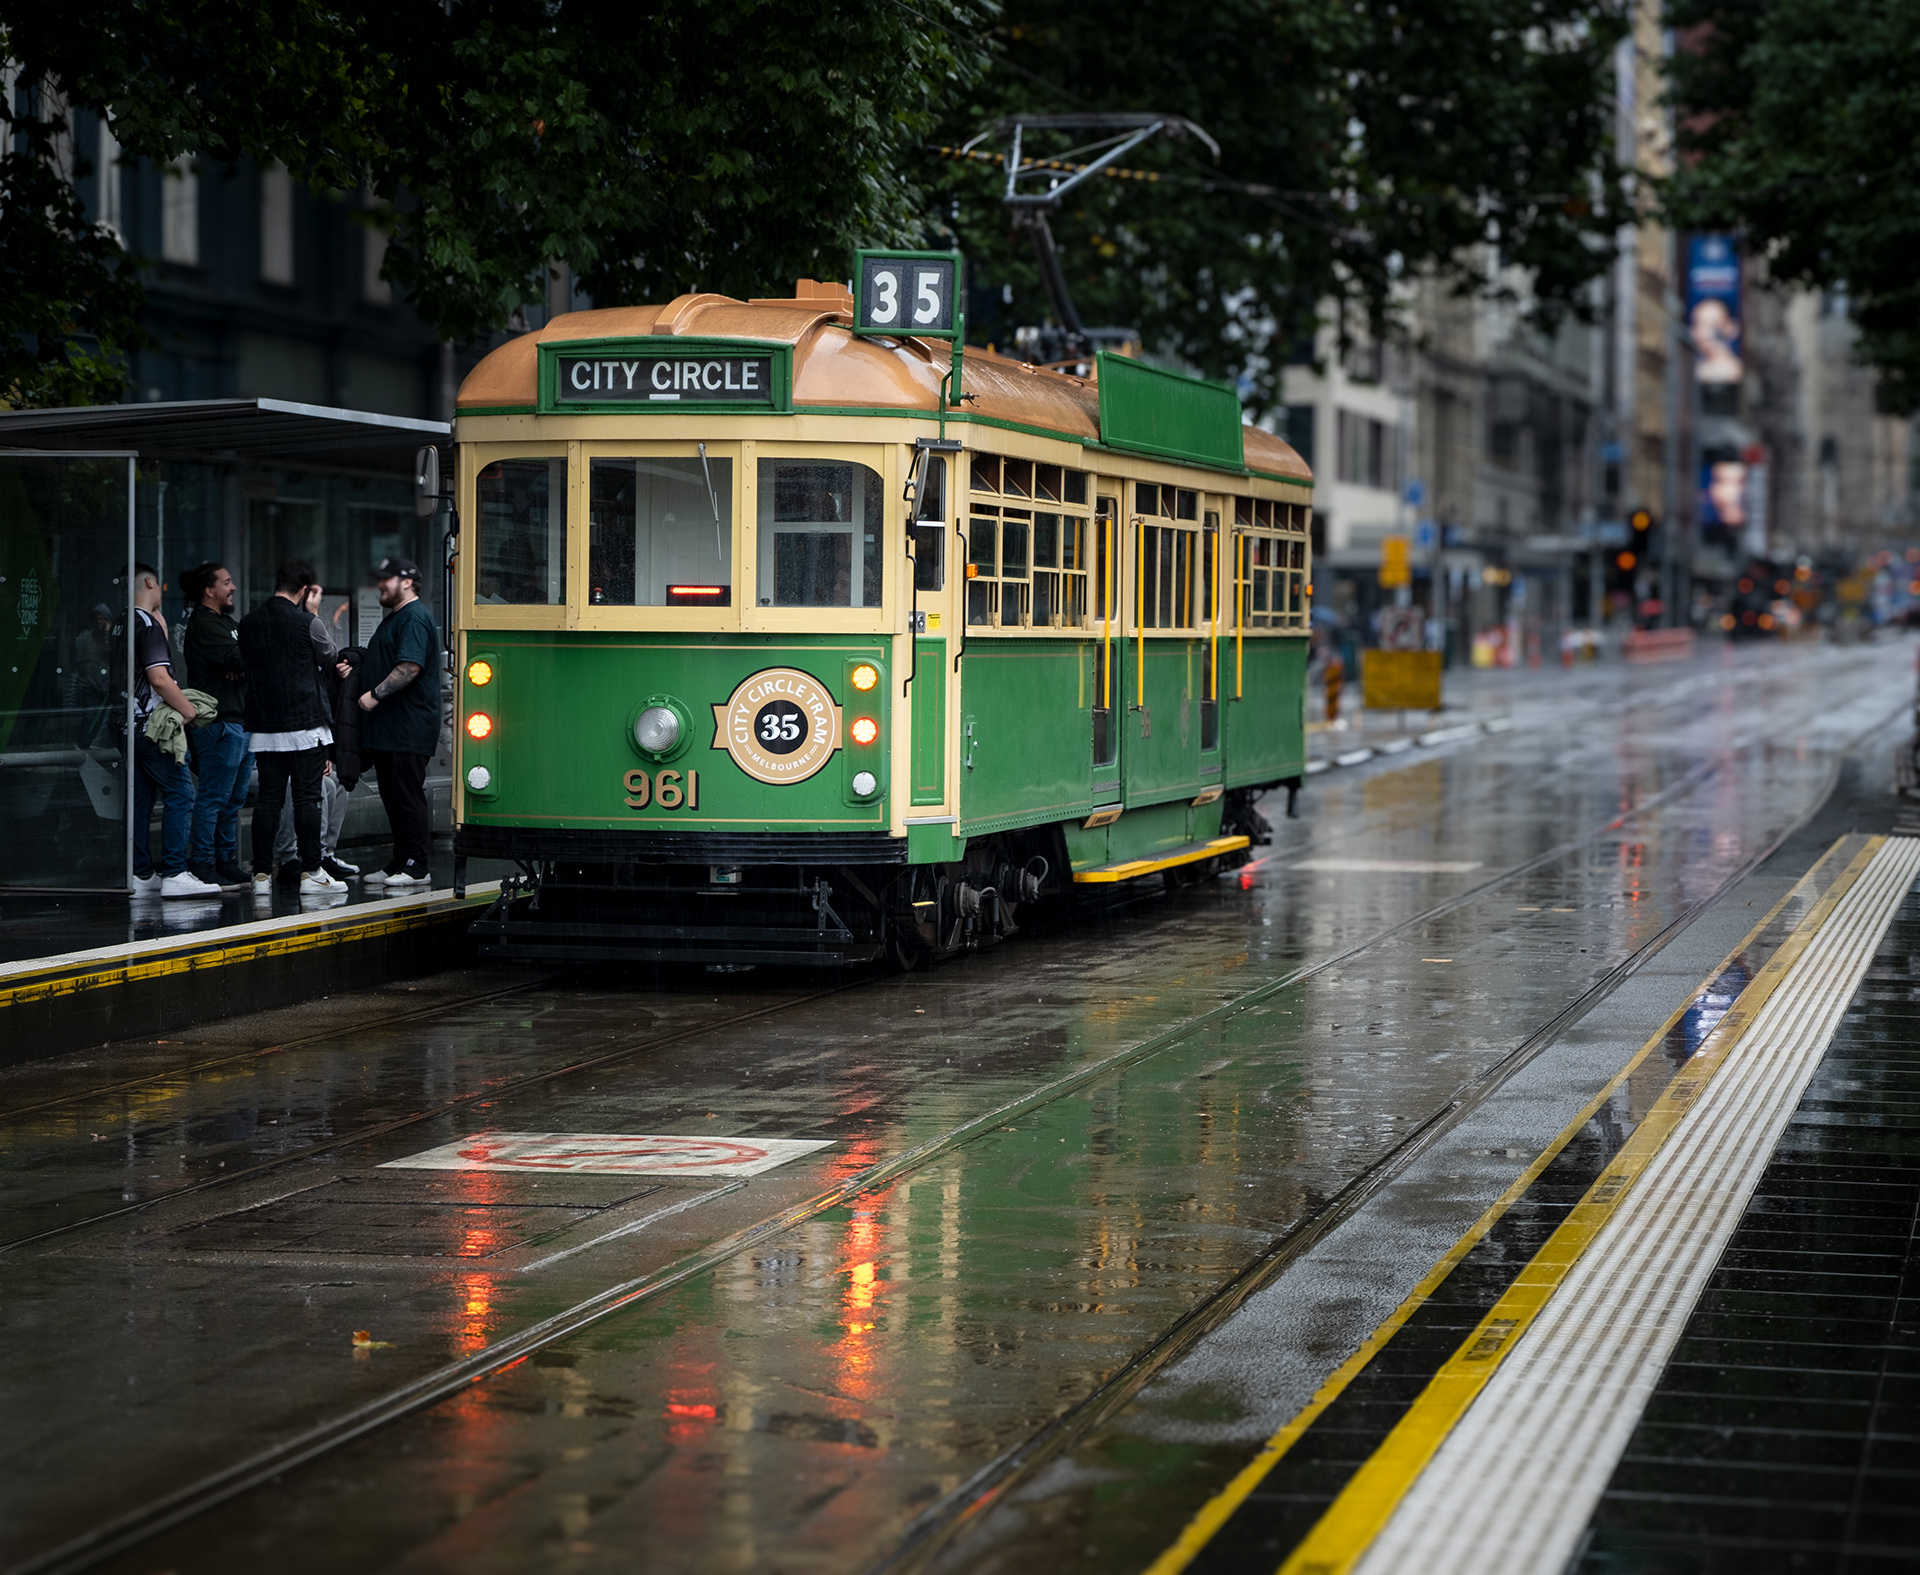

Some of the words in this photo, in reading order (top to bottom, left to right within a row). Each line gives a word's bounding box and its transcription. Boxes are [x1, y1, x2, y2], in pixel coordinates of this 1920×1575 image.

[869, 270, 941, 325] 35
[570, 360, 640, 391] CITY
[650, 360, 760, 391] CIRCLE
[21, 578, 38, 593] FREE
[21, 594, 38, 609] TRAM
[21, 609, 38, 625] ZONE
[733, 703, 751, 744] CITY
[747, 679, 807, 704] CIRCLE
[809, 692, 829, 745] TRAM
[760, 713, 801, 741] 35
[751, 752, 812, 772] MELBOURNE
[623, 769, 699, 810] 961
